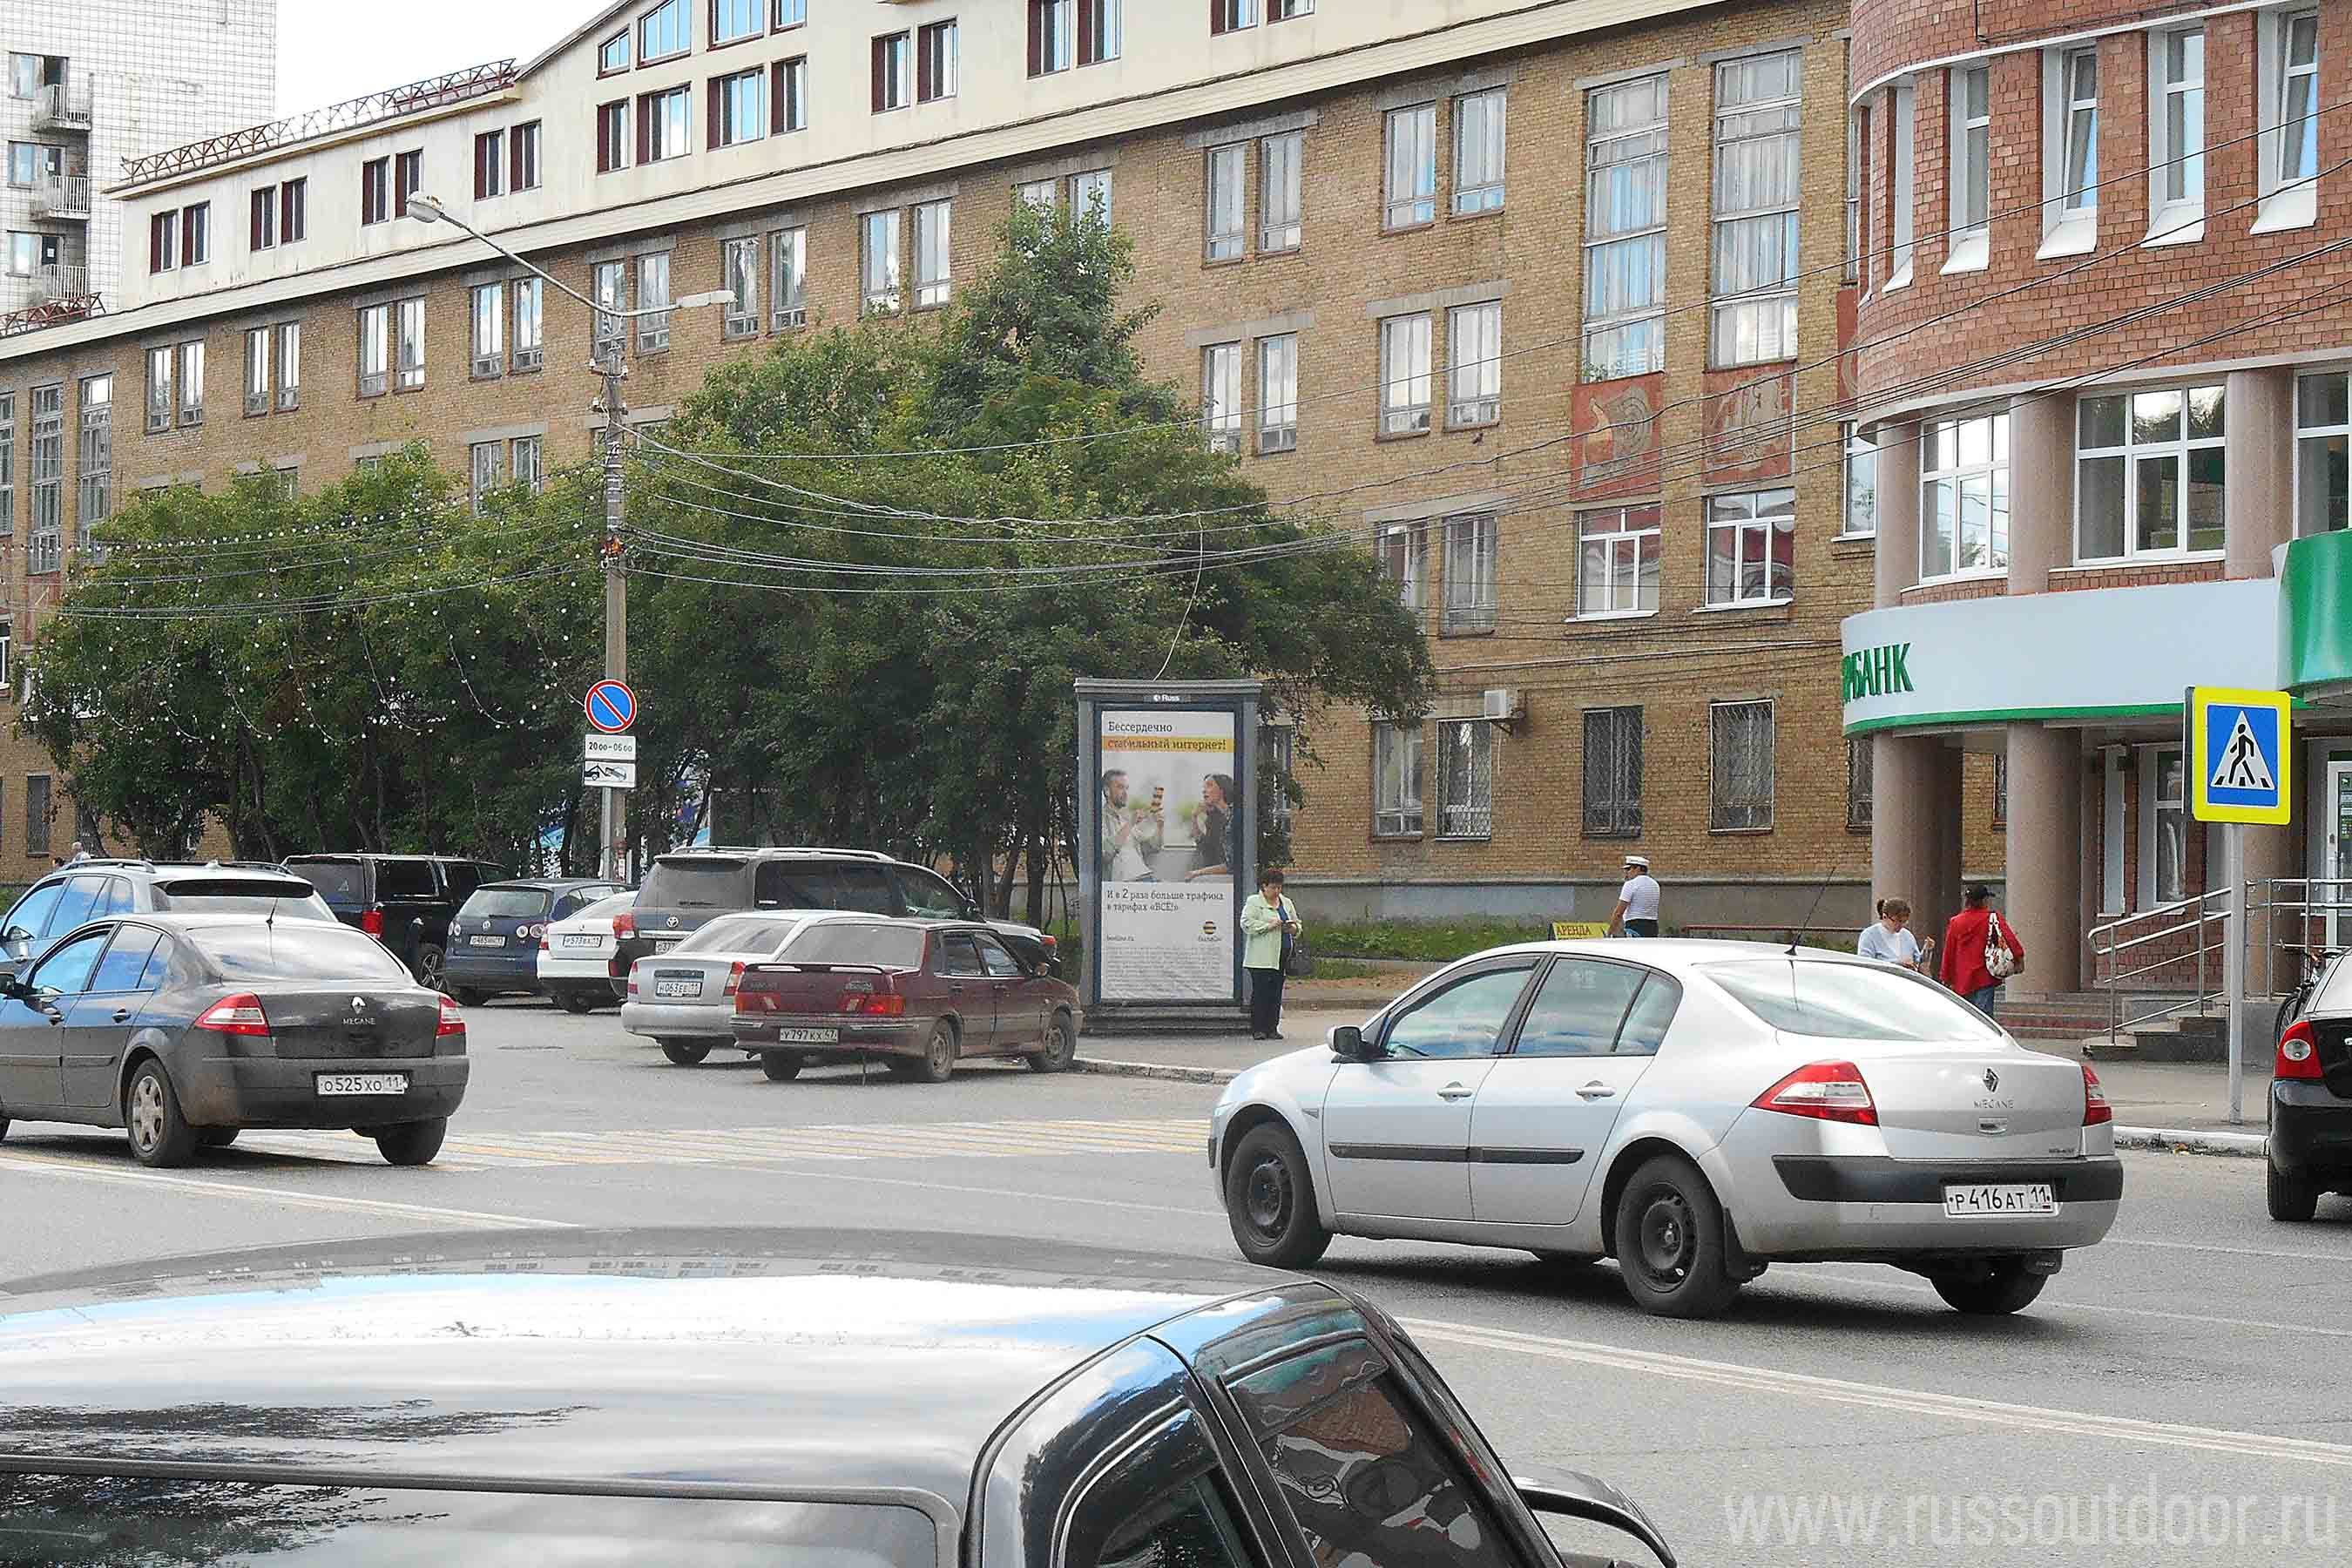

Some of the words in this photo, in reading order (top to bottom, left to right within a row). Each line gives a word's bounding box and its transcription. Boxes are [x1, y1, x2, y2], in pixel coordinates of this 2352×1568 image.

[1108, 721, 1173, 733] Бессердечно
[1107, 739, 1170, 749] стабильный
[1173, 740, 1227, 751] интернет!
[1122, 889, 1129, 899] 2
[1151, 890, 1185, 900] больше
[1114, 902, 1148, 913] тарифах
[1557, 925, 1592, 936] АРЕНДА
